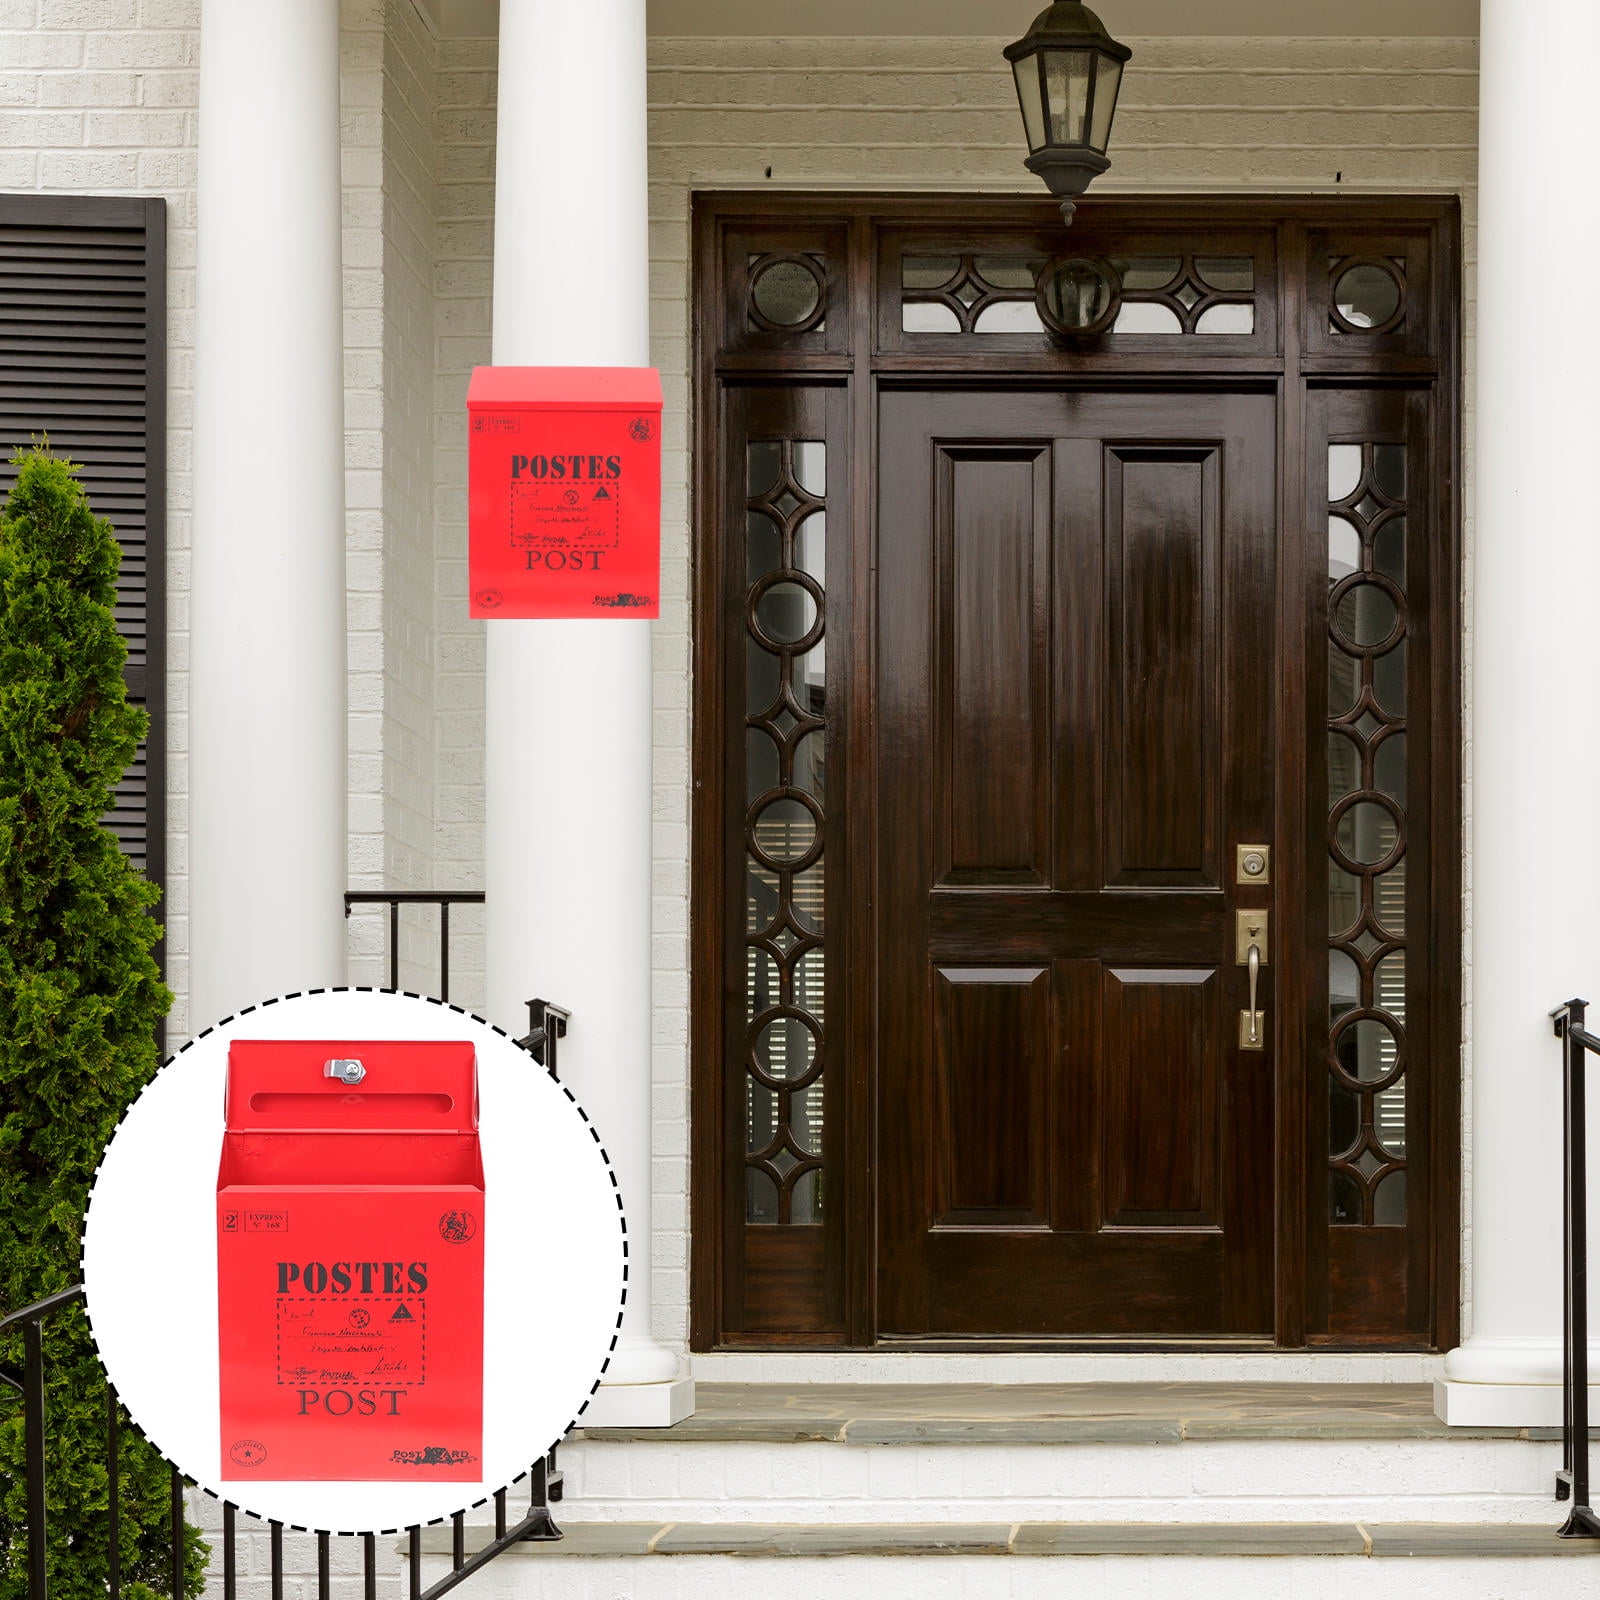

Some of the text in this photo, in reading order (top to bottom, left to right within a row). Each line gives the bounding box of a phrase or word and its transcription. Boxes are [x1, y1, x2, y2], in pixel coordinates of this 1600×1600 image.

[511, 455, 621, 479] POSTES
[525, 550, 606, 570] POST
[277, 1262, 429, 1294] POSTES
[296, 1389, 408, 1416] POST
